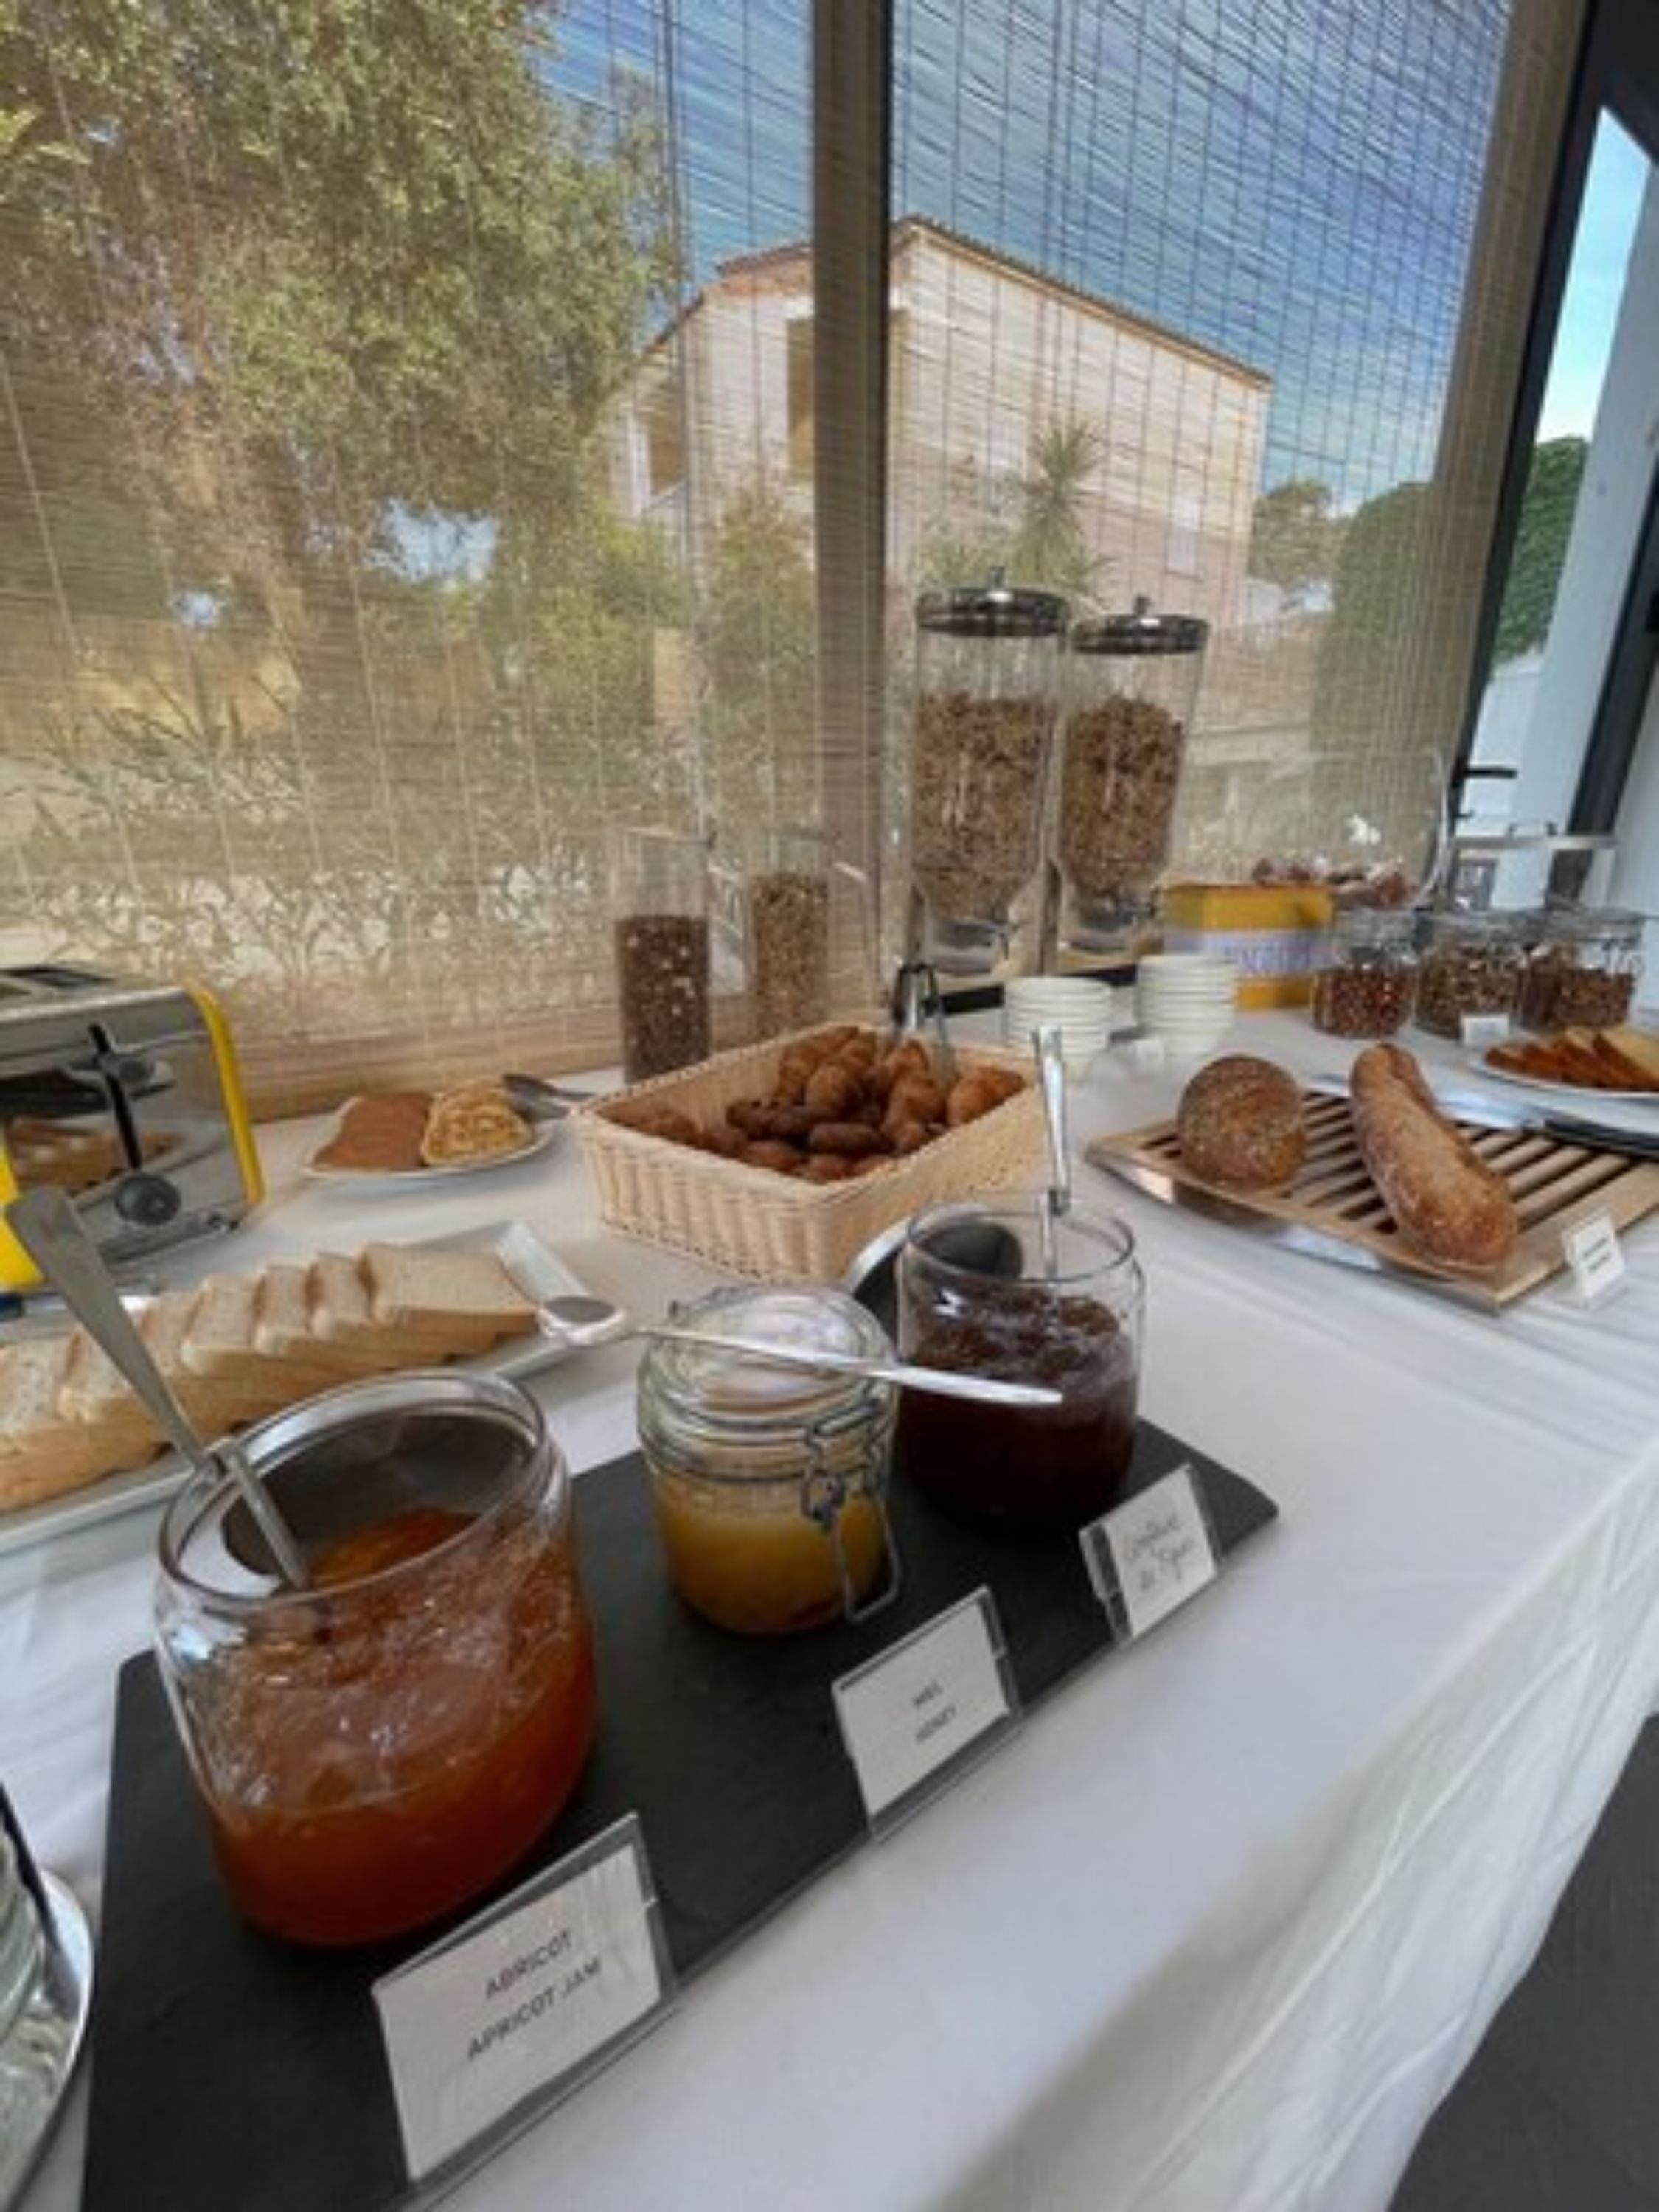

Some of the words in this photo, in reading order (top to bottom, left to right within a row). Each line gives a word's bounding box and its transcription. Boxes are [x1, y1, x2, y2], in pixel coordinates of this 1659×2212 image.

[485, 1929, 572, 1999] ABRICOT
[467, 1986, 556, 2061] APRICOT
[563, 1956, 602, 1998] JAM
